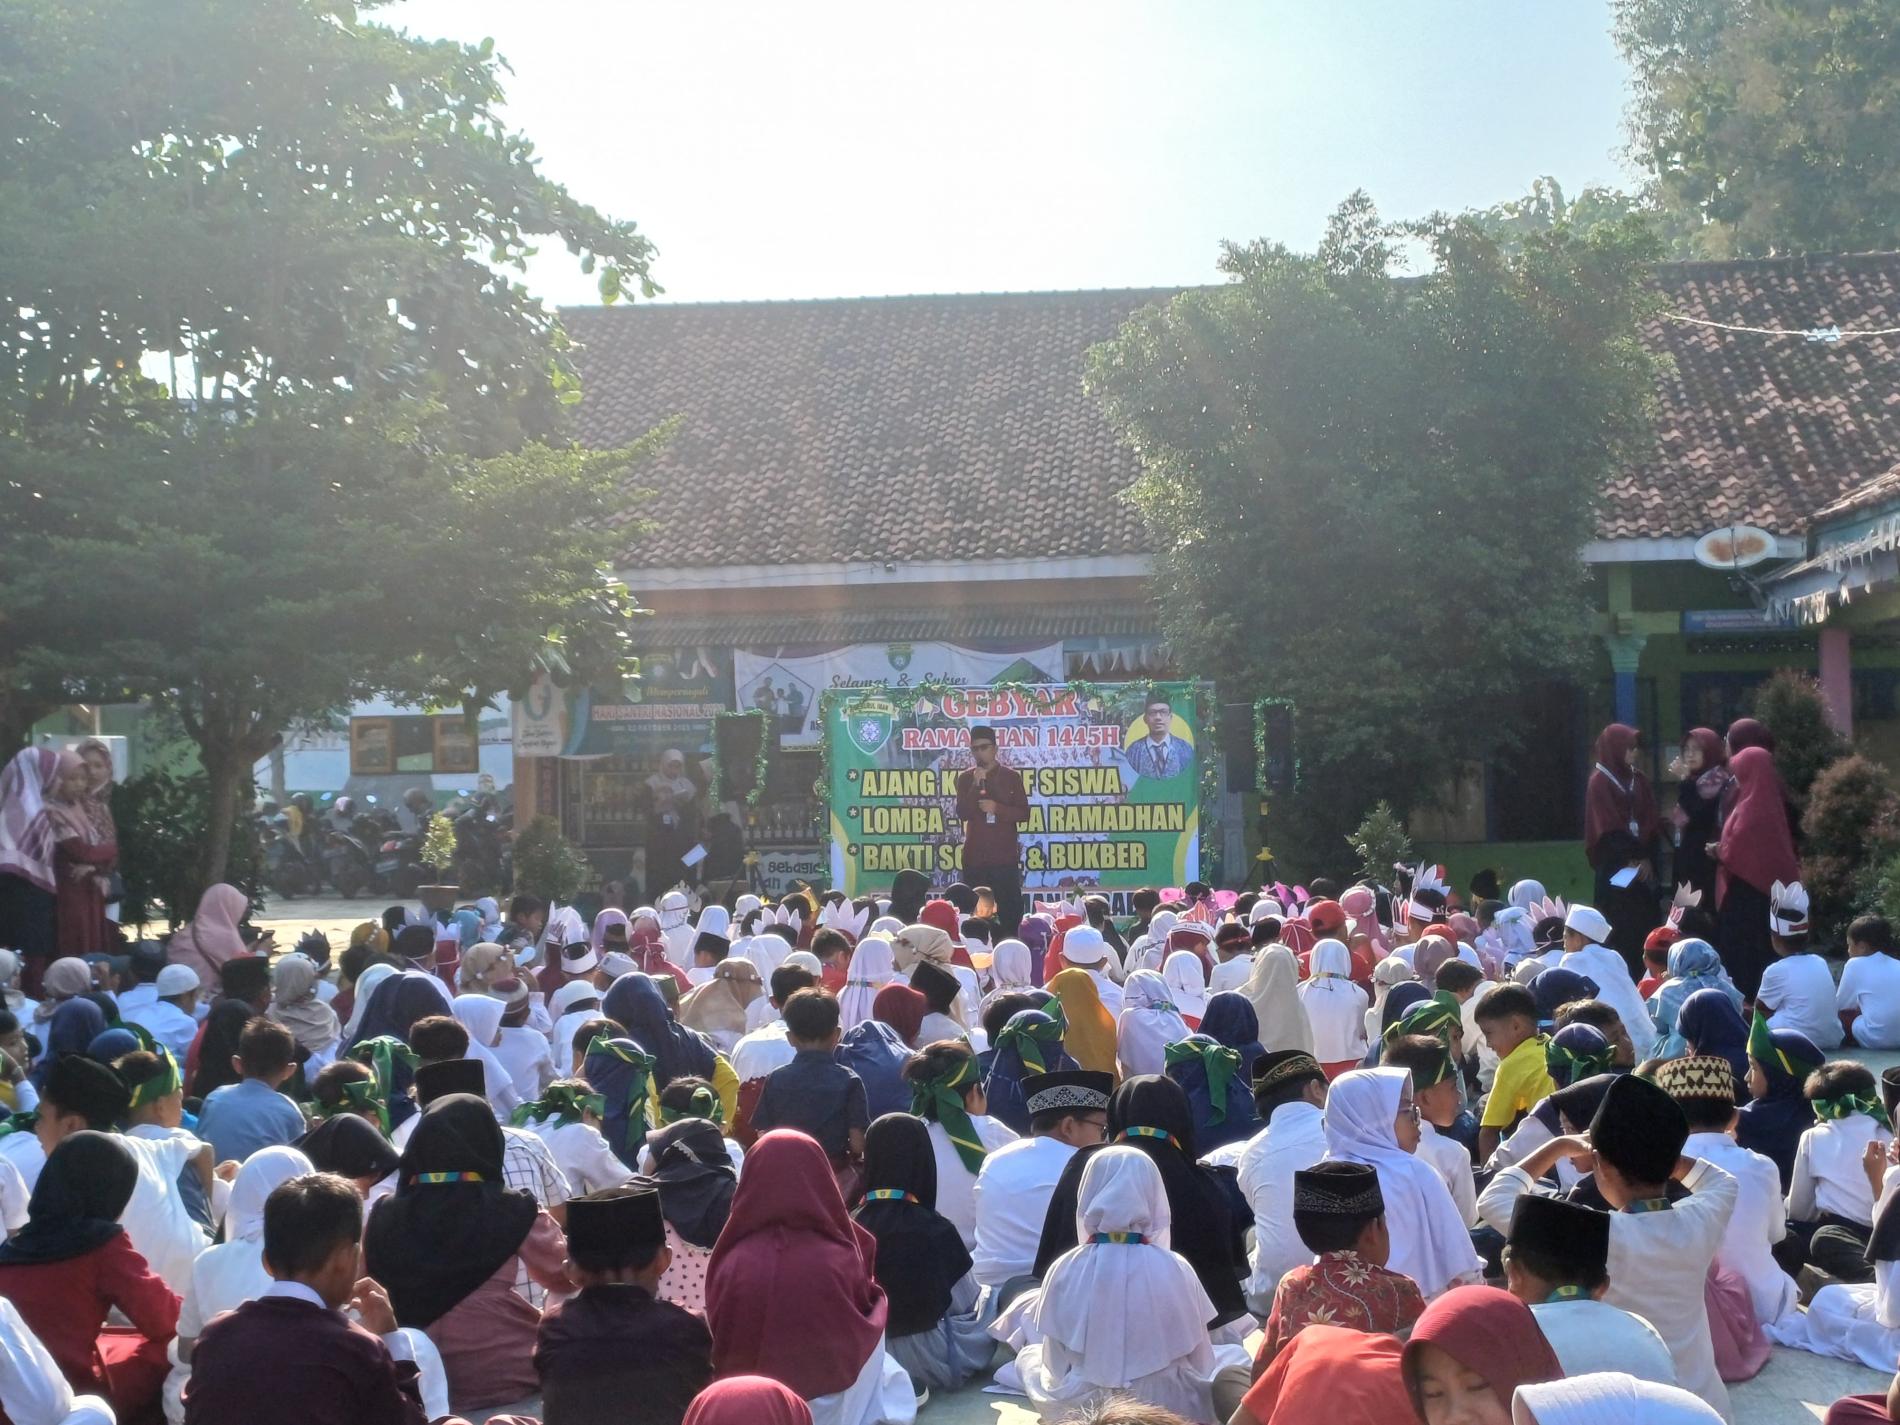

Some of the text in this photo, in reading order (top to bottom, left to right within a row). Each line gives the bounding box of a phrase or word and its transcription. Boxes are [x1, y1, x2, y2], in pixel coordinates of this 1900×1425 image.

[897, 673, 912, 687] &
[943, 688, 1079, 718] GEBYAR
[902, 725, 1120, 749] RAMAHAN 1445H
[861, 770, 936, 797] AJANG
[1039, 768, 1121, 795] SISWA
[862, 807, 944, 834] LOMBA
[1050, 804, 1184, 832] RAMADHAN
[863, 844, 934, 871] BAKTI
[1026, 846, 1045, 869] &
[1050, 842, 1146, 869] BUKBER
